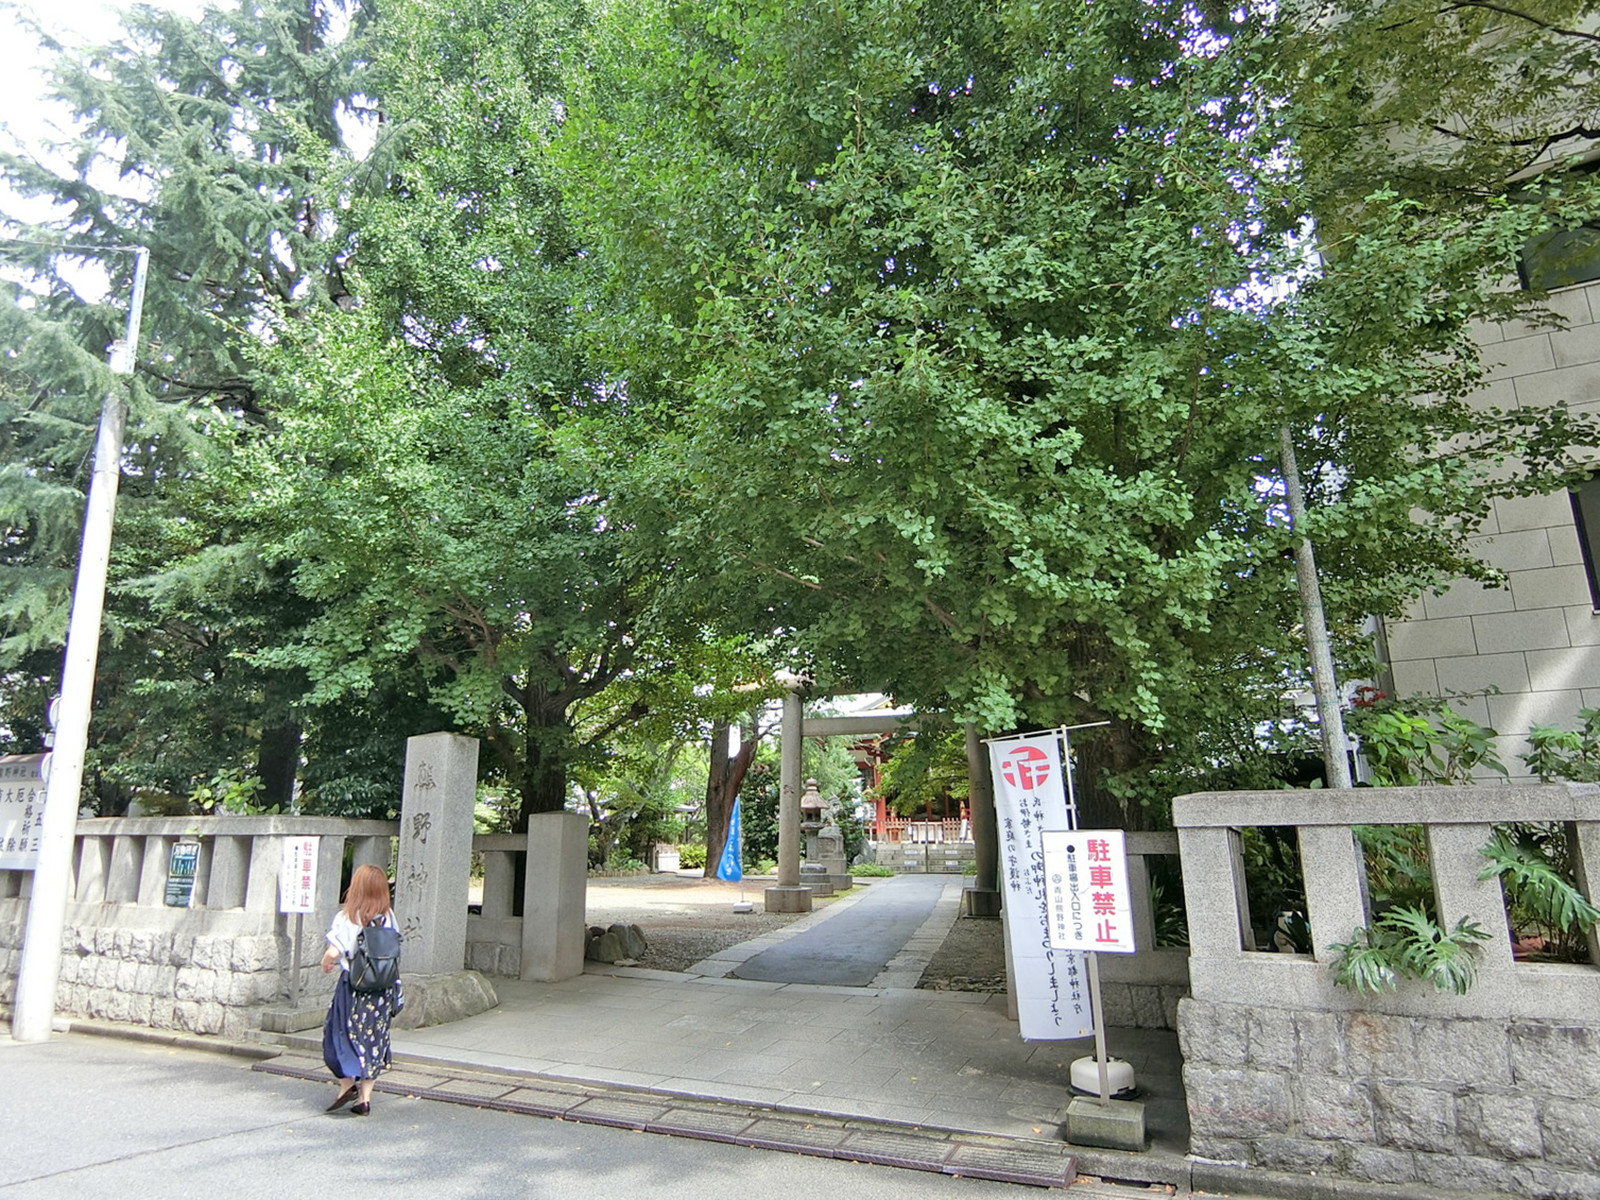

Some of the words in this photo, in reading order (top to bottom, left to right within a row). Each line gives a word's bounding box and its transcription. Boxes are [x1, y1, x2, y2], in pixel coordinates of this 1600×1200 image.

[300, 841, 312, 907] 駐車禁止
[402, 760, 436, 941] 熊野神社
[1066, 853, 1084, 941] 駐車場出入口につき
[1087, 838, 1119, 943] 駐車禁止
